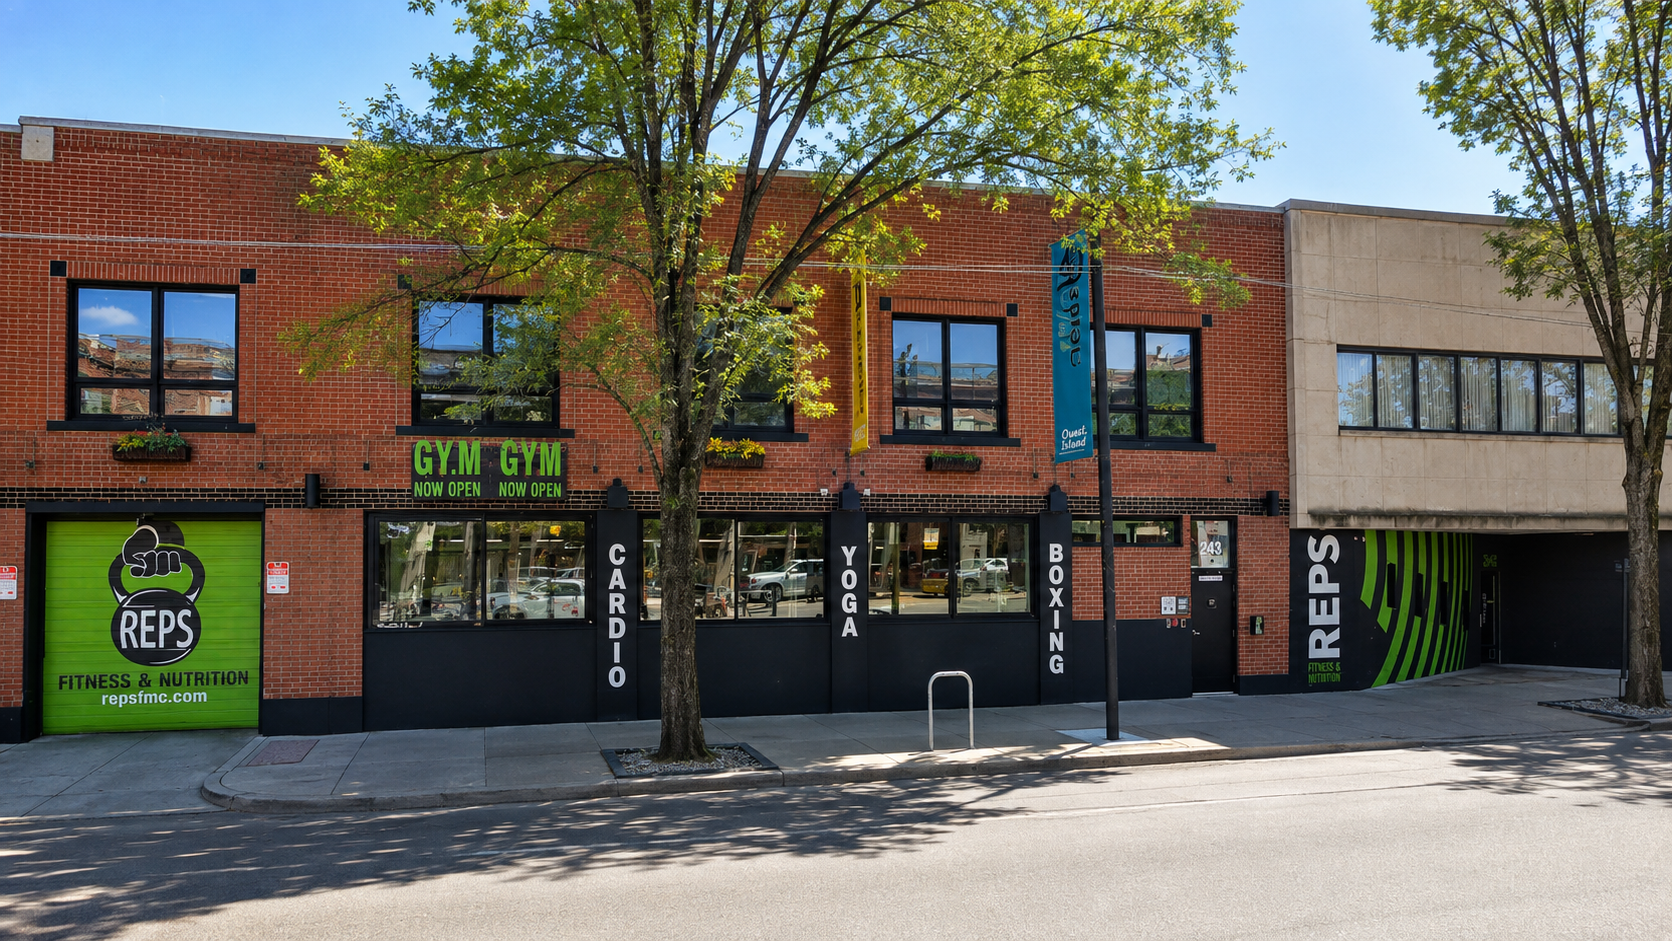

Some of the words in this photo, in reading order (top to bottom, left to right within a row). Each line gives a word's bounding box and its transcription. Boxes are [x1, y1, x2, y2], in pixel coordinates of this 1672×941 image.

[500, 439, 561, 476] GYM
[1061, 436, 1087, 450] Island
[414, 481, 444, 497] NOW
[448, 481, 481, 497] OPEN
[499, 481, 527, 497] NOW
[530, 482, 561, 497] OPEN
[1200, 541, 1222, 555] 243
[841, 545, 858, 637] YOGA
[1049, 543, 1064, 674] BOXING
[1307, 534, 1340, 659] REPS
[120, 609, 194, 649] REPS
[608, 543, 627, 688] CARDIO
[58, 673, 131, 690] FITNESS
[138, 673, 151, 688] &
[159, 670, 249, 687] NUTRITION
[102, 690, 208, 708] repsfmc.com
